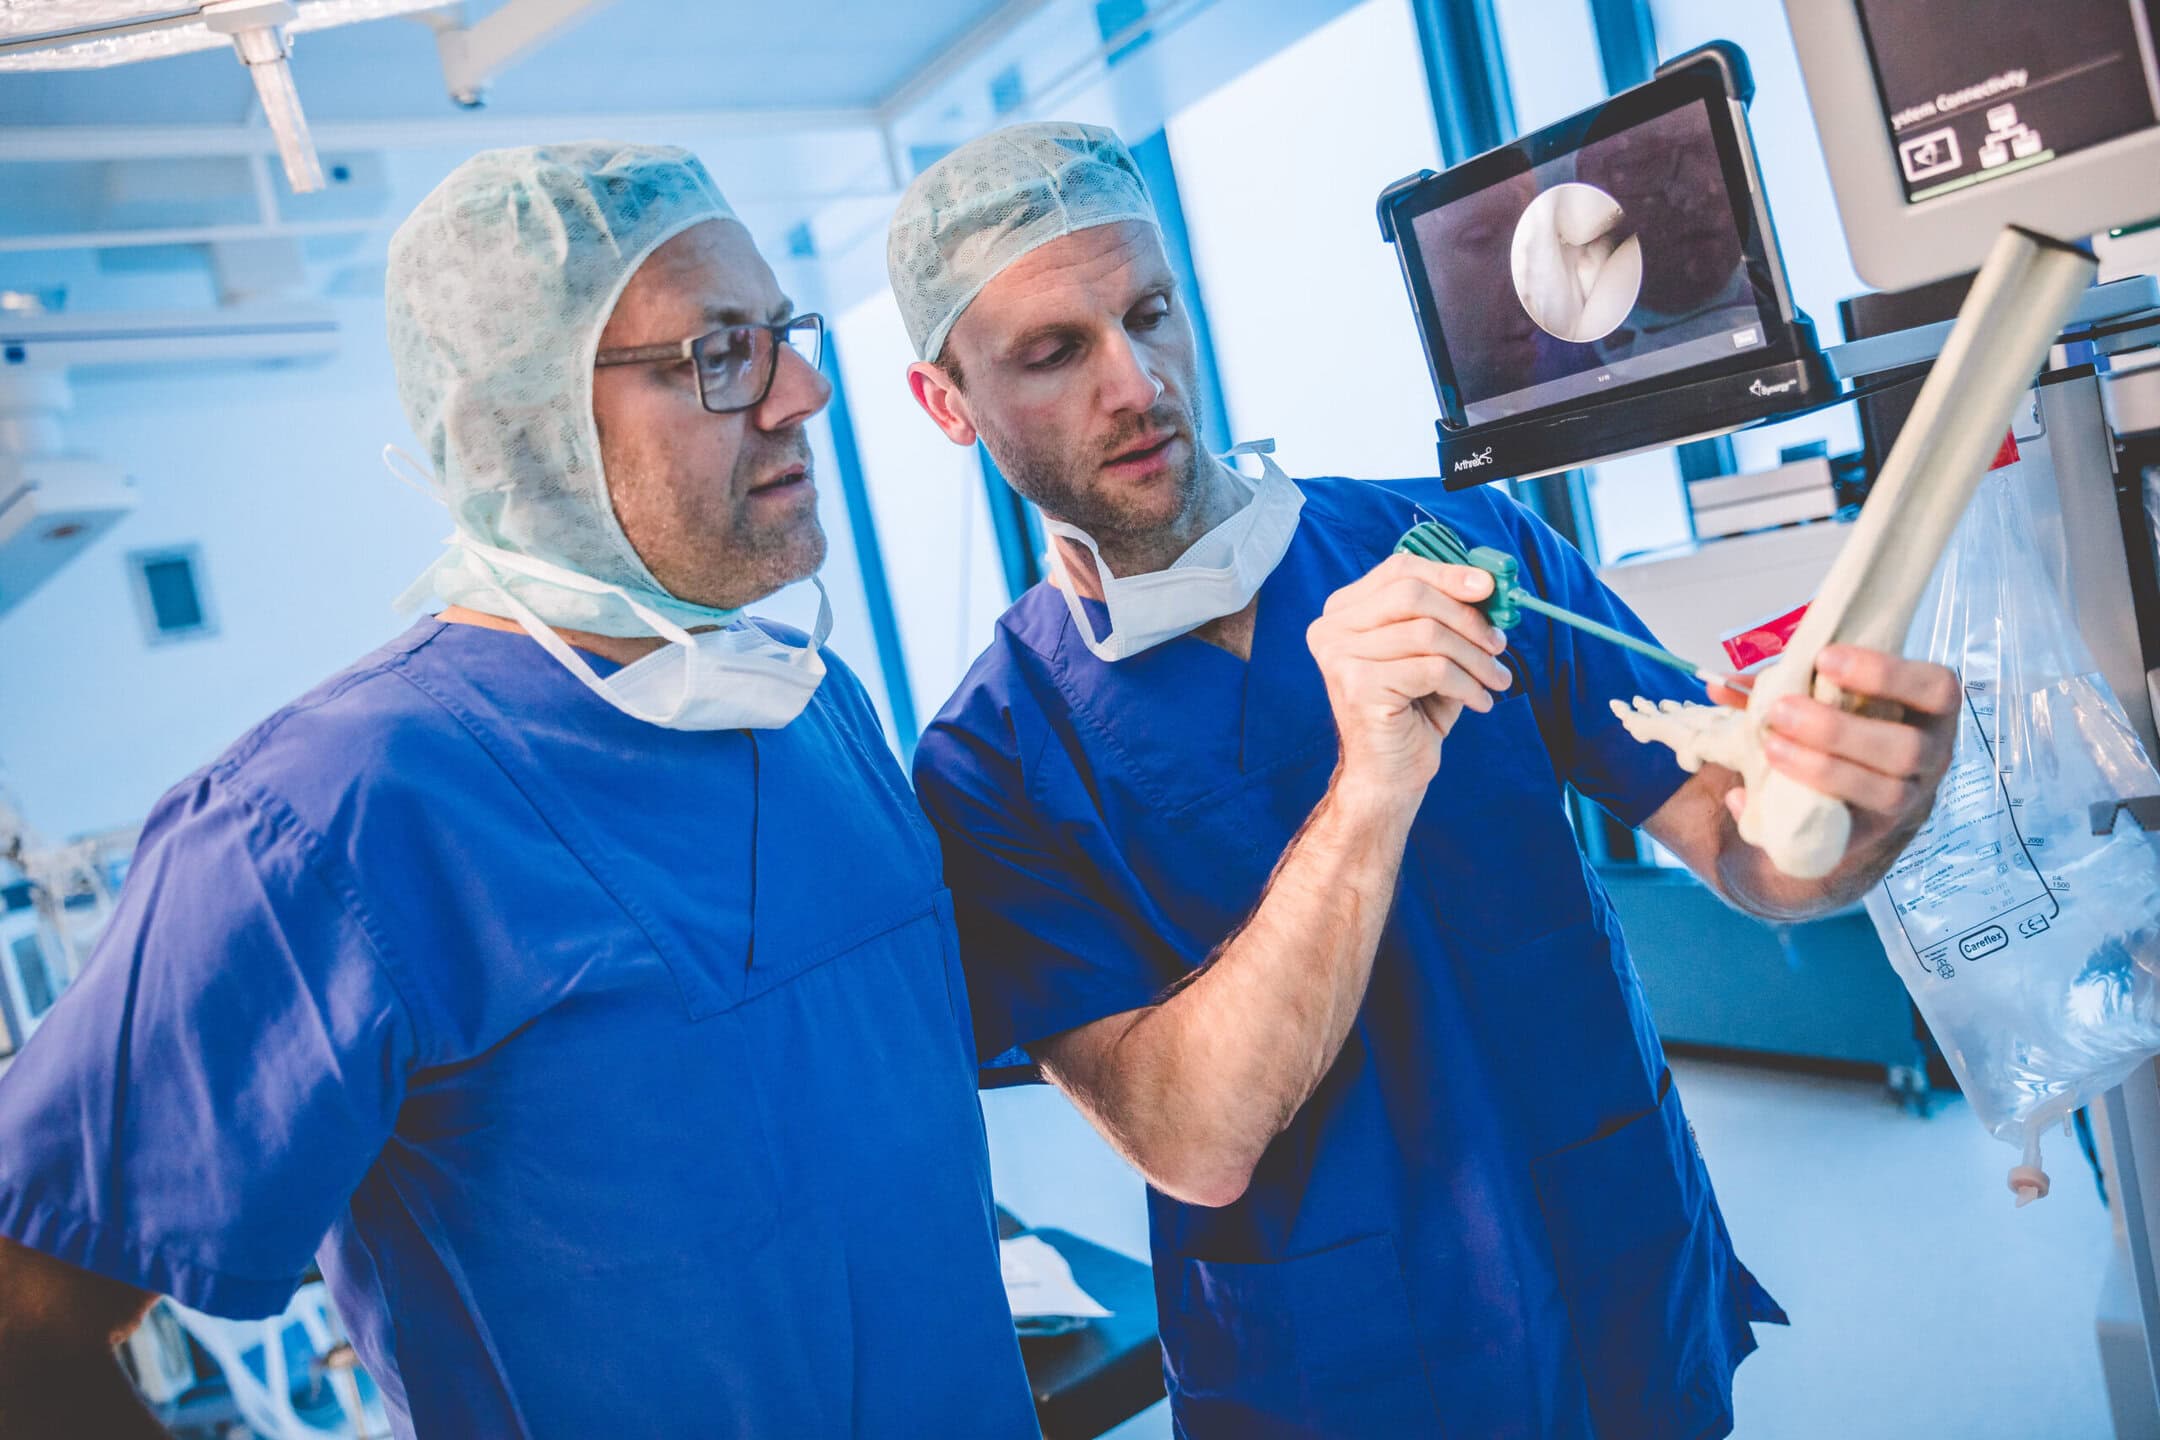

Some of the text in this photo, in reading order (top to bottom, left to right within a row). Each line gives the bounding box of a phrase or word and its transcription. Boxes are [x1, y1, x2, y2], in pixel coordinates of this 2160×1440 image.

[1891, 68, 2029, 131] ystem Connectivity
[1454, 446, 1493, 472] Arthrex
[2027, 836, 2045, 844] 2000
[2052, 881, 2071, 889] 1500
[1964, 932, 2004, 954] Careflex
